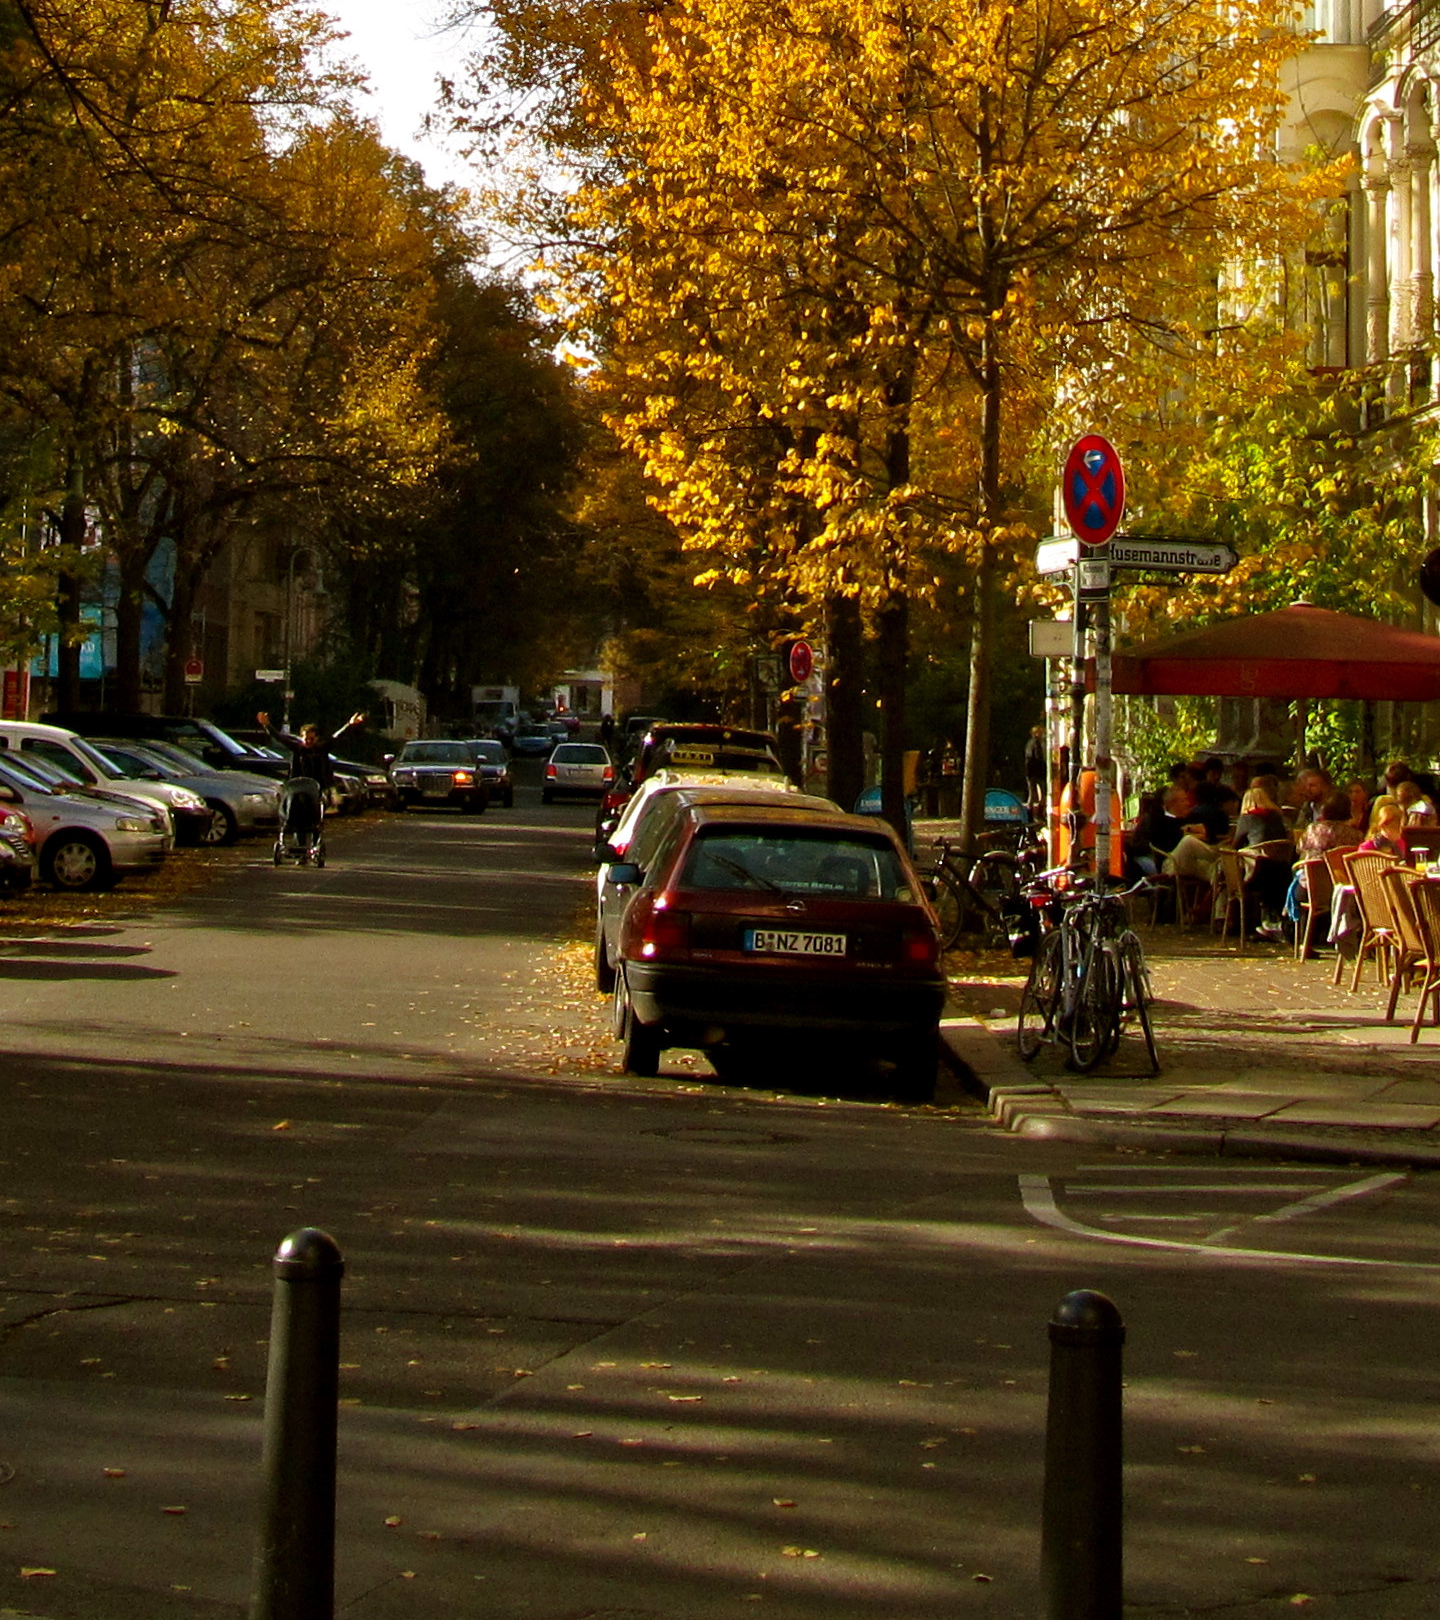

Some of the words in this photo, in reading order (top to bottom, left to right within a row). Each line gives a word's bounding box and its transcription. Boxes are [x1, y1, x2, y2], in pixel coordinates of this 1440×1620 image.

[754, 933, 765, 950] B
[776, 935, 799, 952] NZ
[803, 936, 844, 954] 7081
